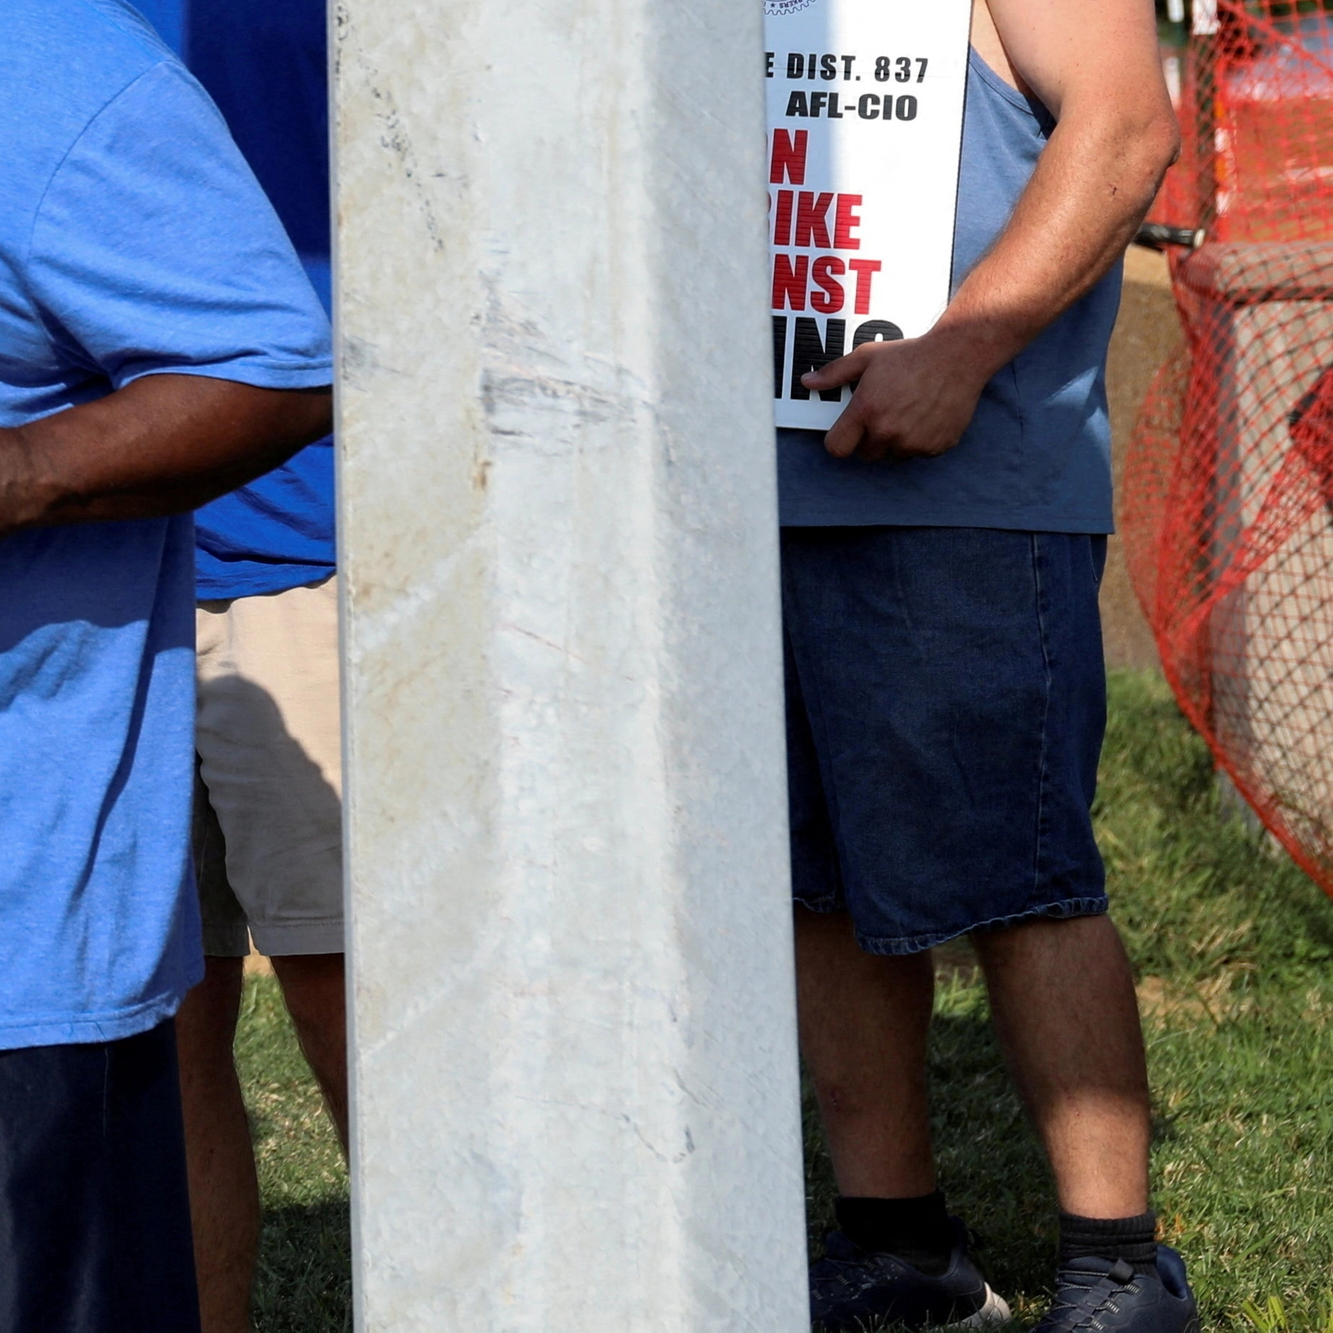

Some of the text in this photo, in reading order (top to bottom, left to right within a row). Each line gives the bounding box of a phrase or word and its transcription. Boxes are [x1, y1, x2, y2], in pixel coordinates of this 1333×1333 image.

[786, 53, 862, 82] DIST.
[874, 57, 929, 84] 837
[785, 91, 918, 121] AFL-CIO
[766, 127, 809, 186] N
